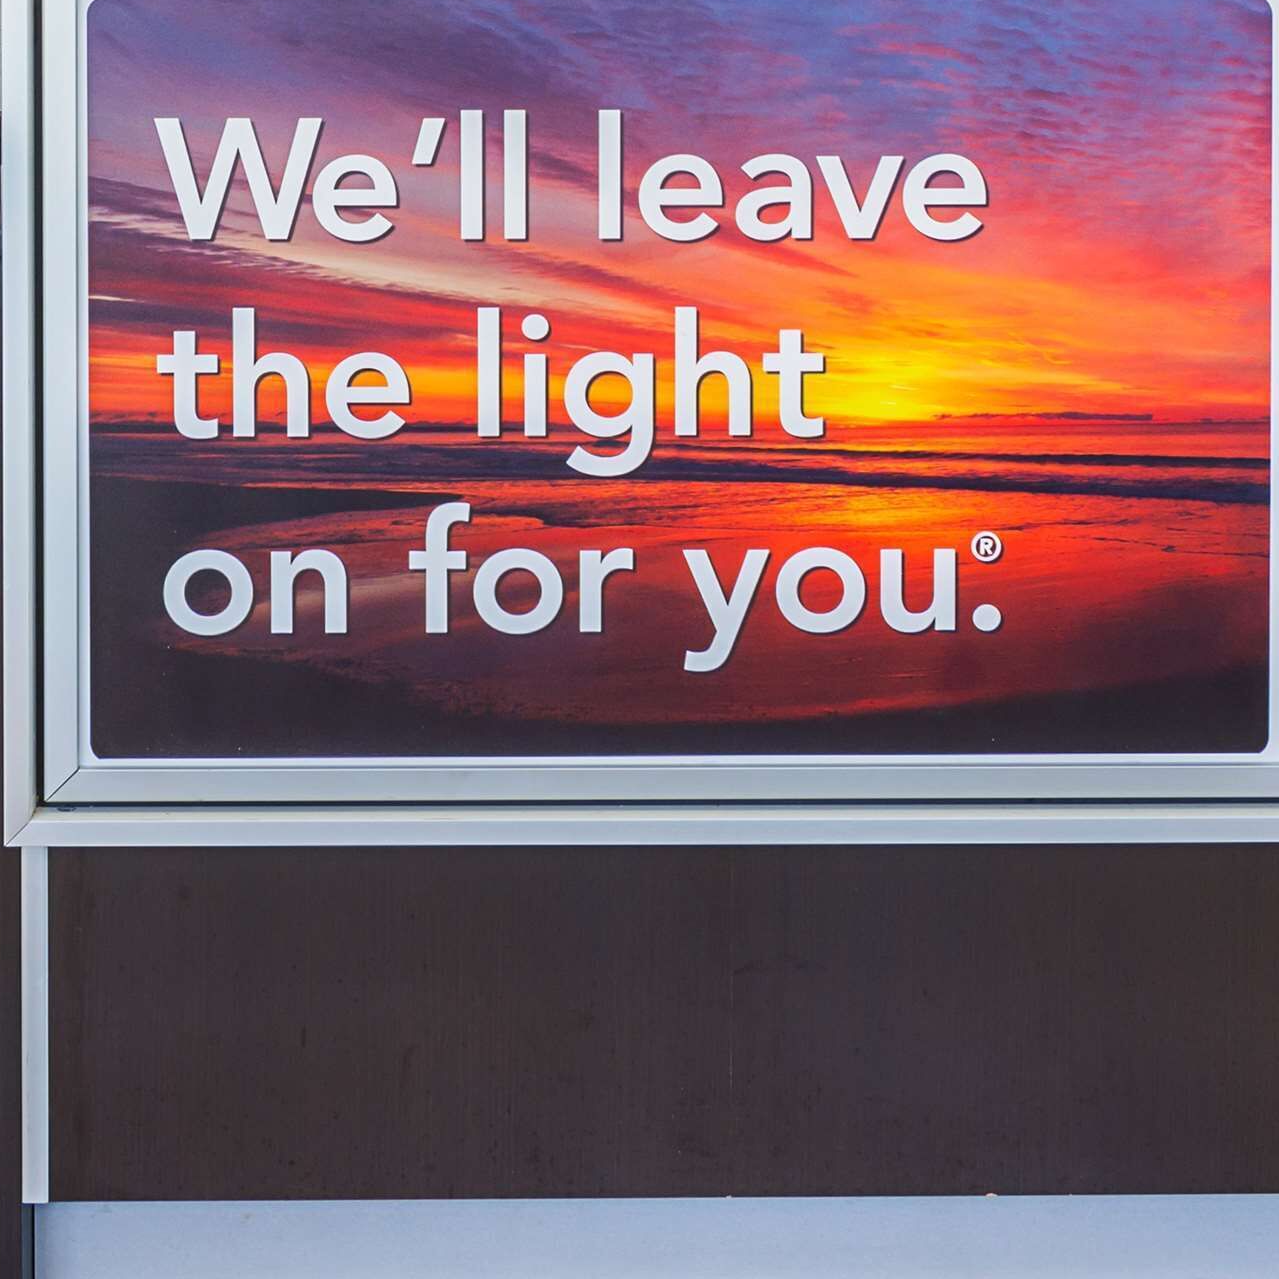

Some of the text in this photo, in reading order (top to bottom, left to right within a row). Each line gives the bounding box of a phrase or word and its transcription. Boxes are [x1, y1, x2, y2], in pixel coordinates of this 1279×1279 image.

[598, 109, 989, 242] leave
[157, 306, 826, 477] the light
[163, 547, 348, 637] on
[409, 502, 634, 637] for
